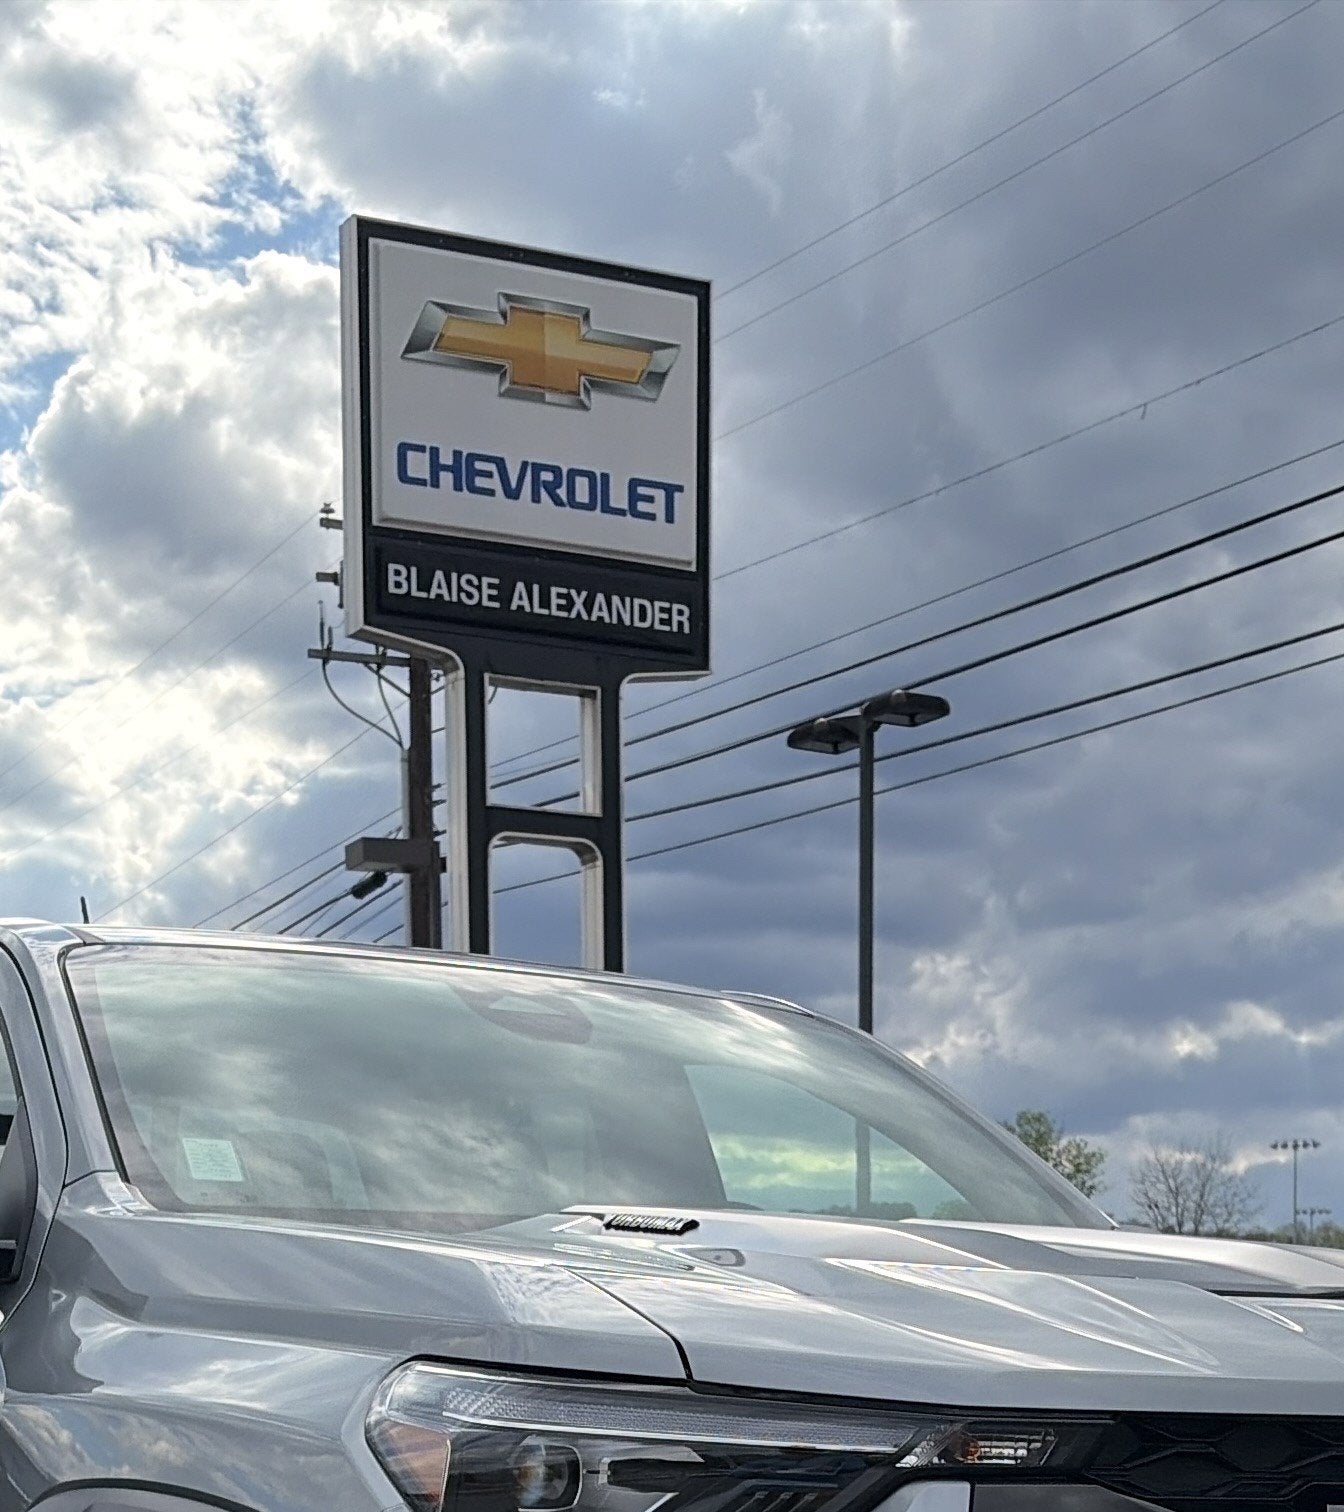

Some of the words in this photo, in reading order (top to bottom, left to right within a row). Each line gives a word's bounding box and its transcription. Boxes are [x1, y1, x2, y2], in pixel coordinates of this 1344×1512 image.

[397, 441, 684, 524] CHEVROLET
[387, 563, 501, 608] BLAISE
[510, 582, 690, 634] ALEXANDER
